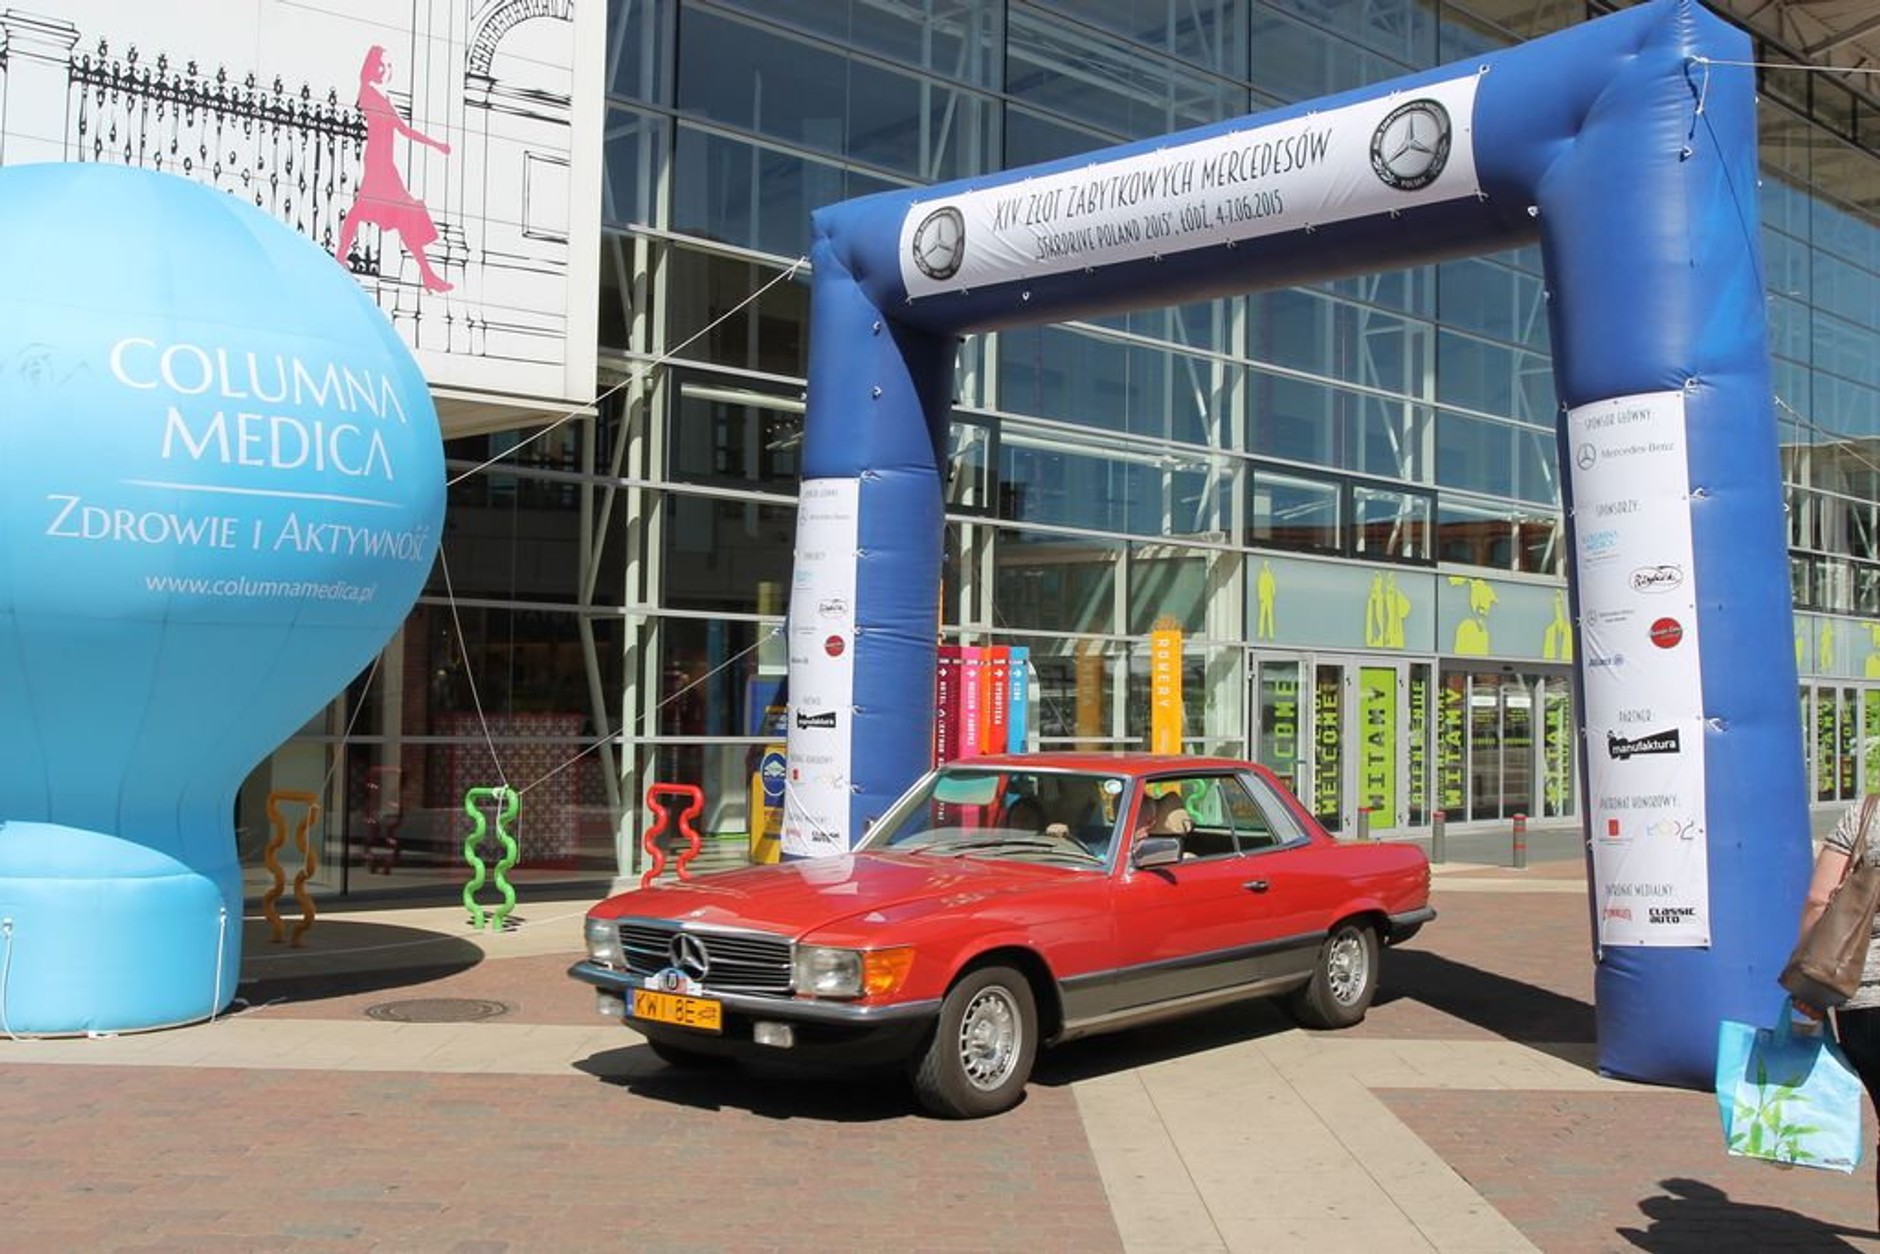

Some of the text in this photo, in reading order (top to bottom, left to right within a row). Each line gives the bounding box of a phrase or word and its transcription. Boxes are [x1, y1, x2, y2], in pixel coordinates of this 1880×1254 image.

[992, 203, 1019, 231] XIV
[1025, 193, 1061, 226] ZŁOT
[1066, 159, 1192, 218] ZABYTKOWYCH
[1200, 128, 1333, 189] MERCEDESÓW
[1098, 220, 1142, 248] POLAND
[109, 337, 407, 424] COLUMNA
[161, 407, 394, 481] MEDICA
[45, 494, 239, 549] ZDROWIE
[145, 574, 376, 602] www.columnamedica.pl
[1157, 638, 1170, 707] ROWERY
[1321, 692, 1338, 815] WELCOME
[1445, 688, 1461, 806] WITAMY
[1611, 739, 1677, 754] manufaktura
